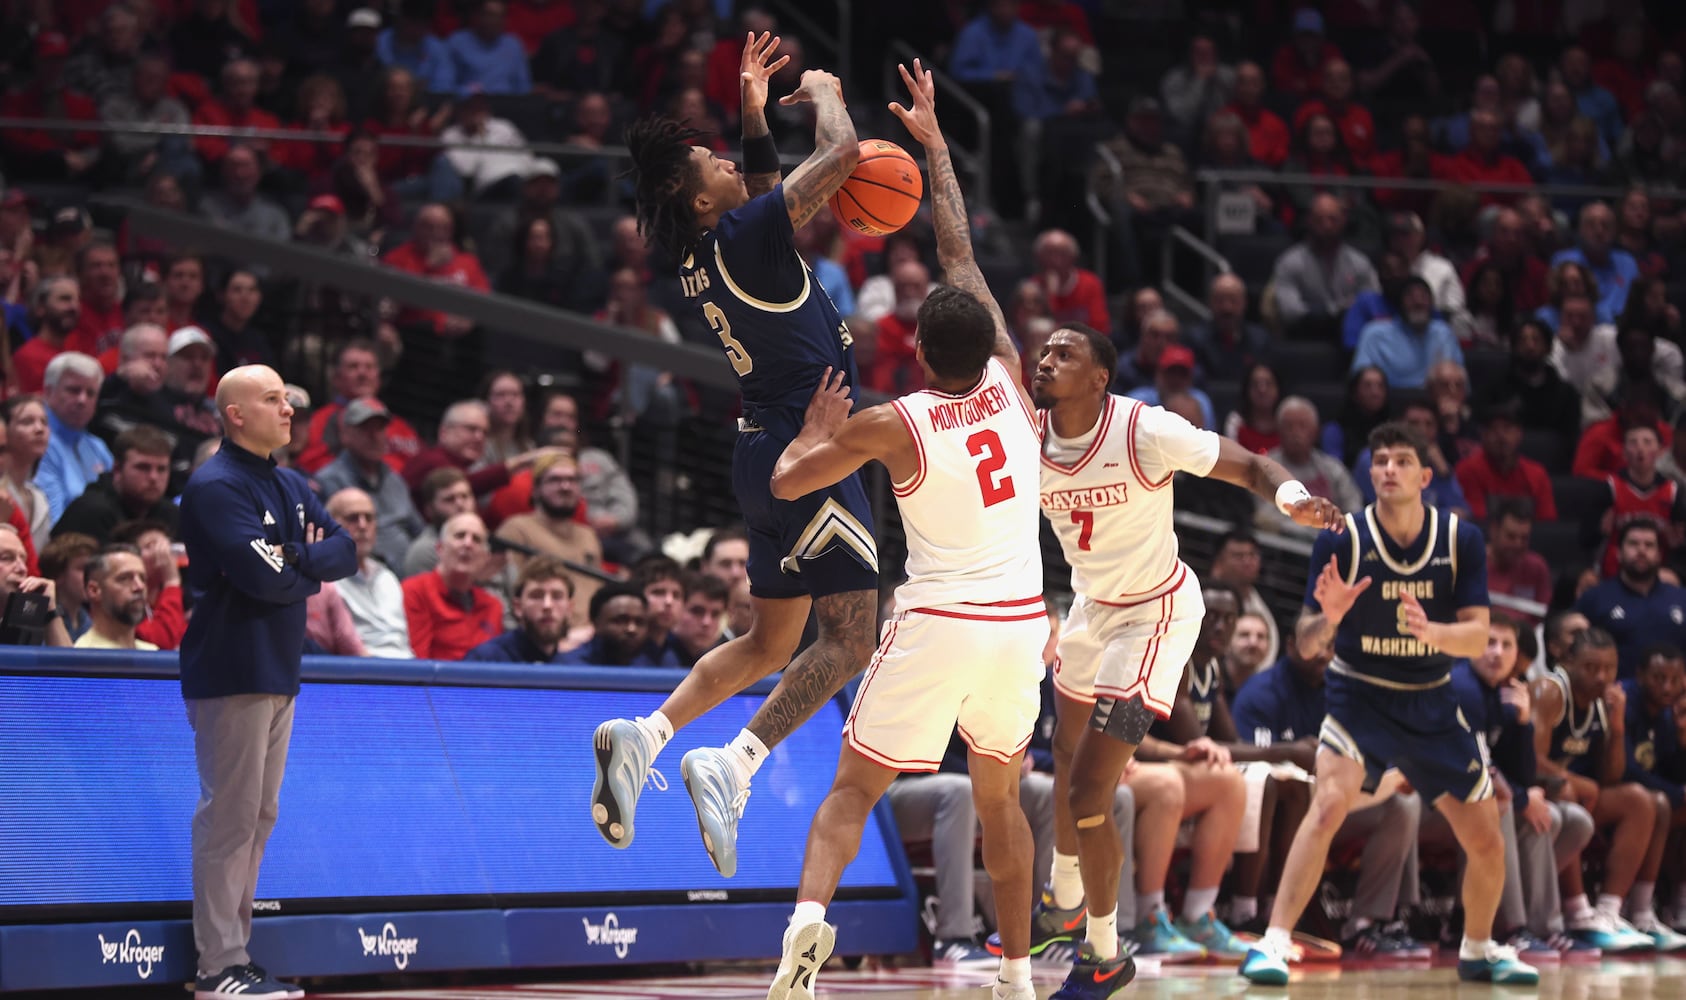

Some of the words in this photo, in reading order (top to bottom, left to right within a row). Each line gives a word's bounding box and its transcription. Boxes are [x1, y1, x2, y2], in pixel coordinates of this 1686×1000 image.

[702, 301, 753, 377] 3
[928, 381, 1011, 432] MONTGOMERY
[965, 428, 1016, 508] 2
[1071, 510, 1094, 551] 7
[119, 929, 165, 979] Kroger
[377, 922, 418, 970] Kroger
[600, 912, 638, 959] Kroger
